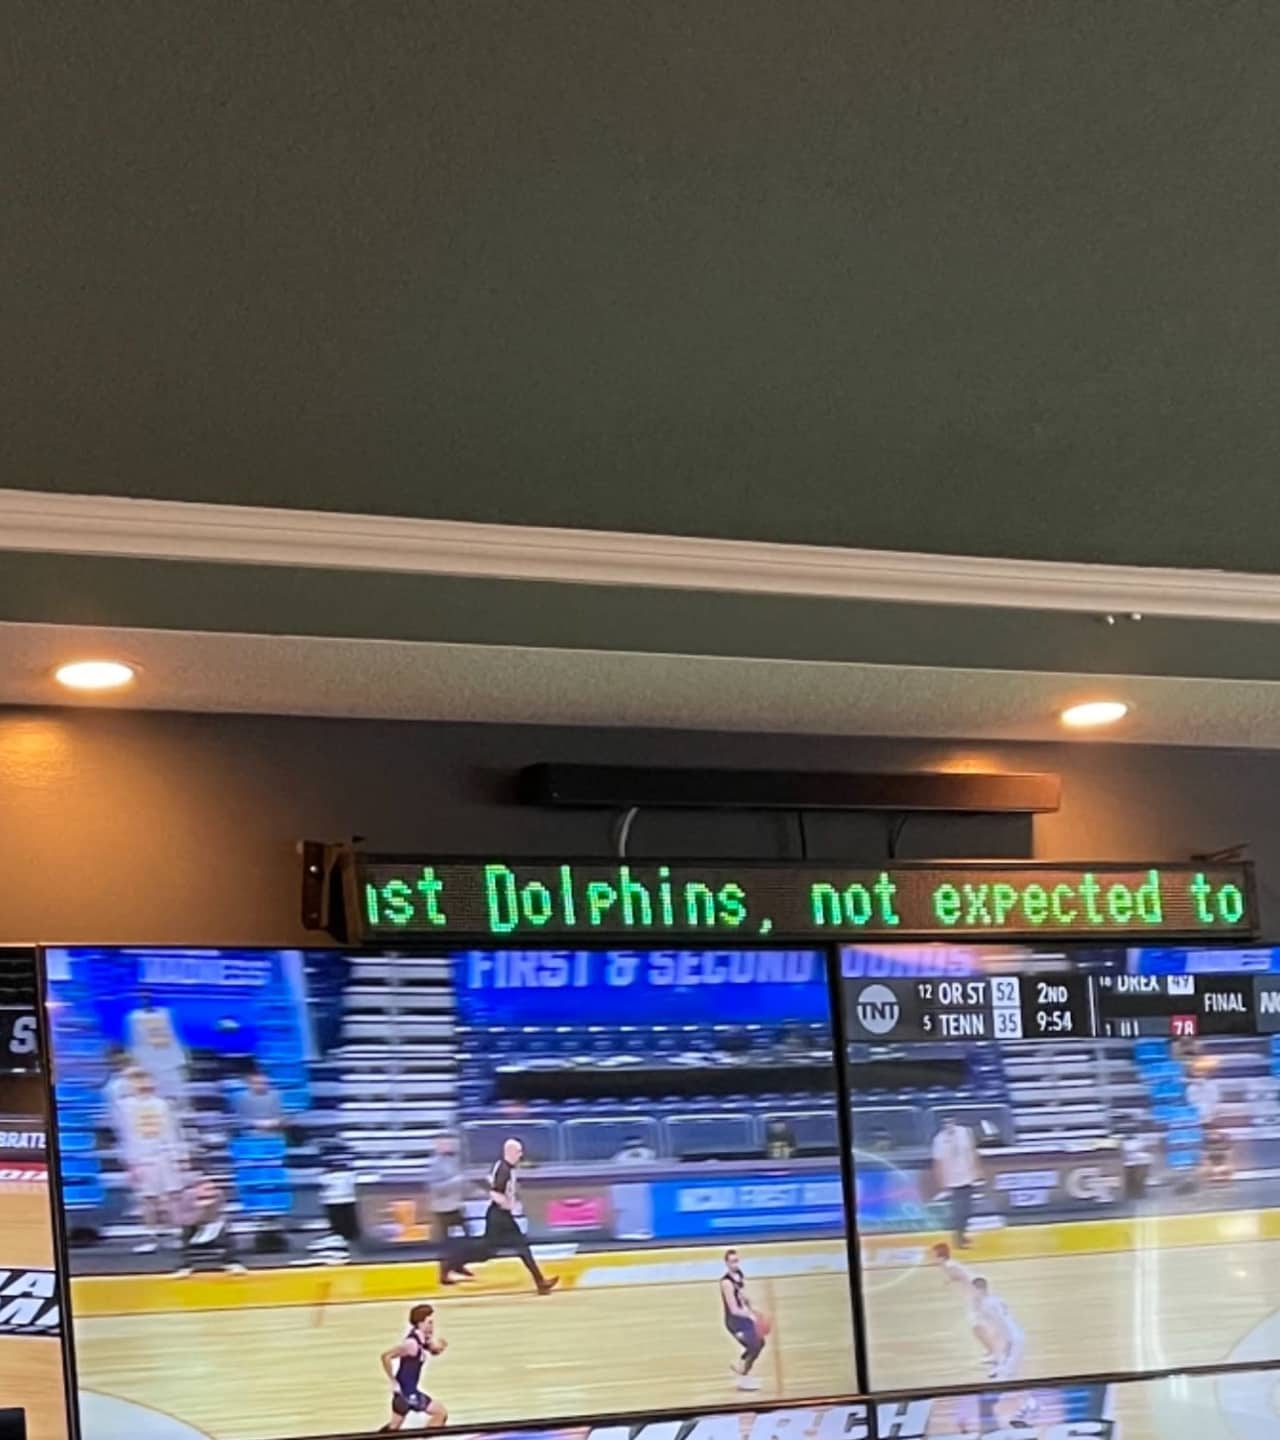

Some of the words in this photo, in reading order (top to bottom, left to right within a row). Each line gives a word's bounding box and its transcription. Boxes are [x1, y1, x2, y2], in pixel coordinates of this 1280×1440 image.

[484, 864, 773, 934] Dolphins,
[810, 871, 899, 925] not
[932, 868, 1163, 925] expected
[1189, 872, 1245, 924] to
[918, 983, 933, 1000] 12
[938, 982, 963, 1005] OR
[967, 982, 986, 1004] ST
[996, 981, 1016, 1001] 52
[1036, 982, 1068, 1004] 2ND
[1204, 991, 1247, 1014] FINAL
[922, 1014, 932, 1032] 5
[938, 1012, 985, 1036] TENN
[998, 1013, 1018, 1033] 35
[1036, 1010, 1073, 1032] 9:54
